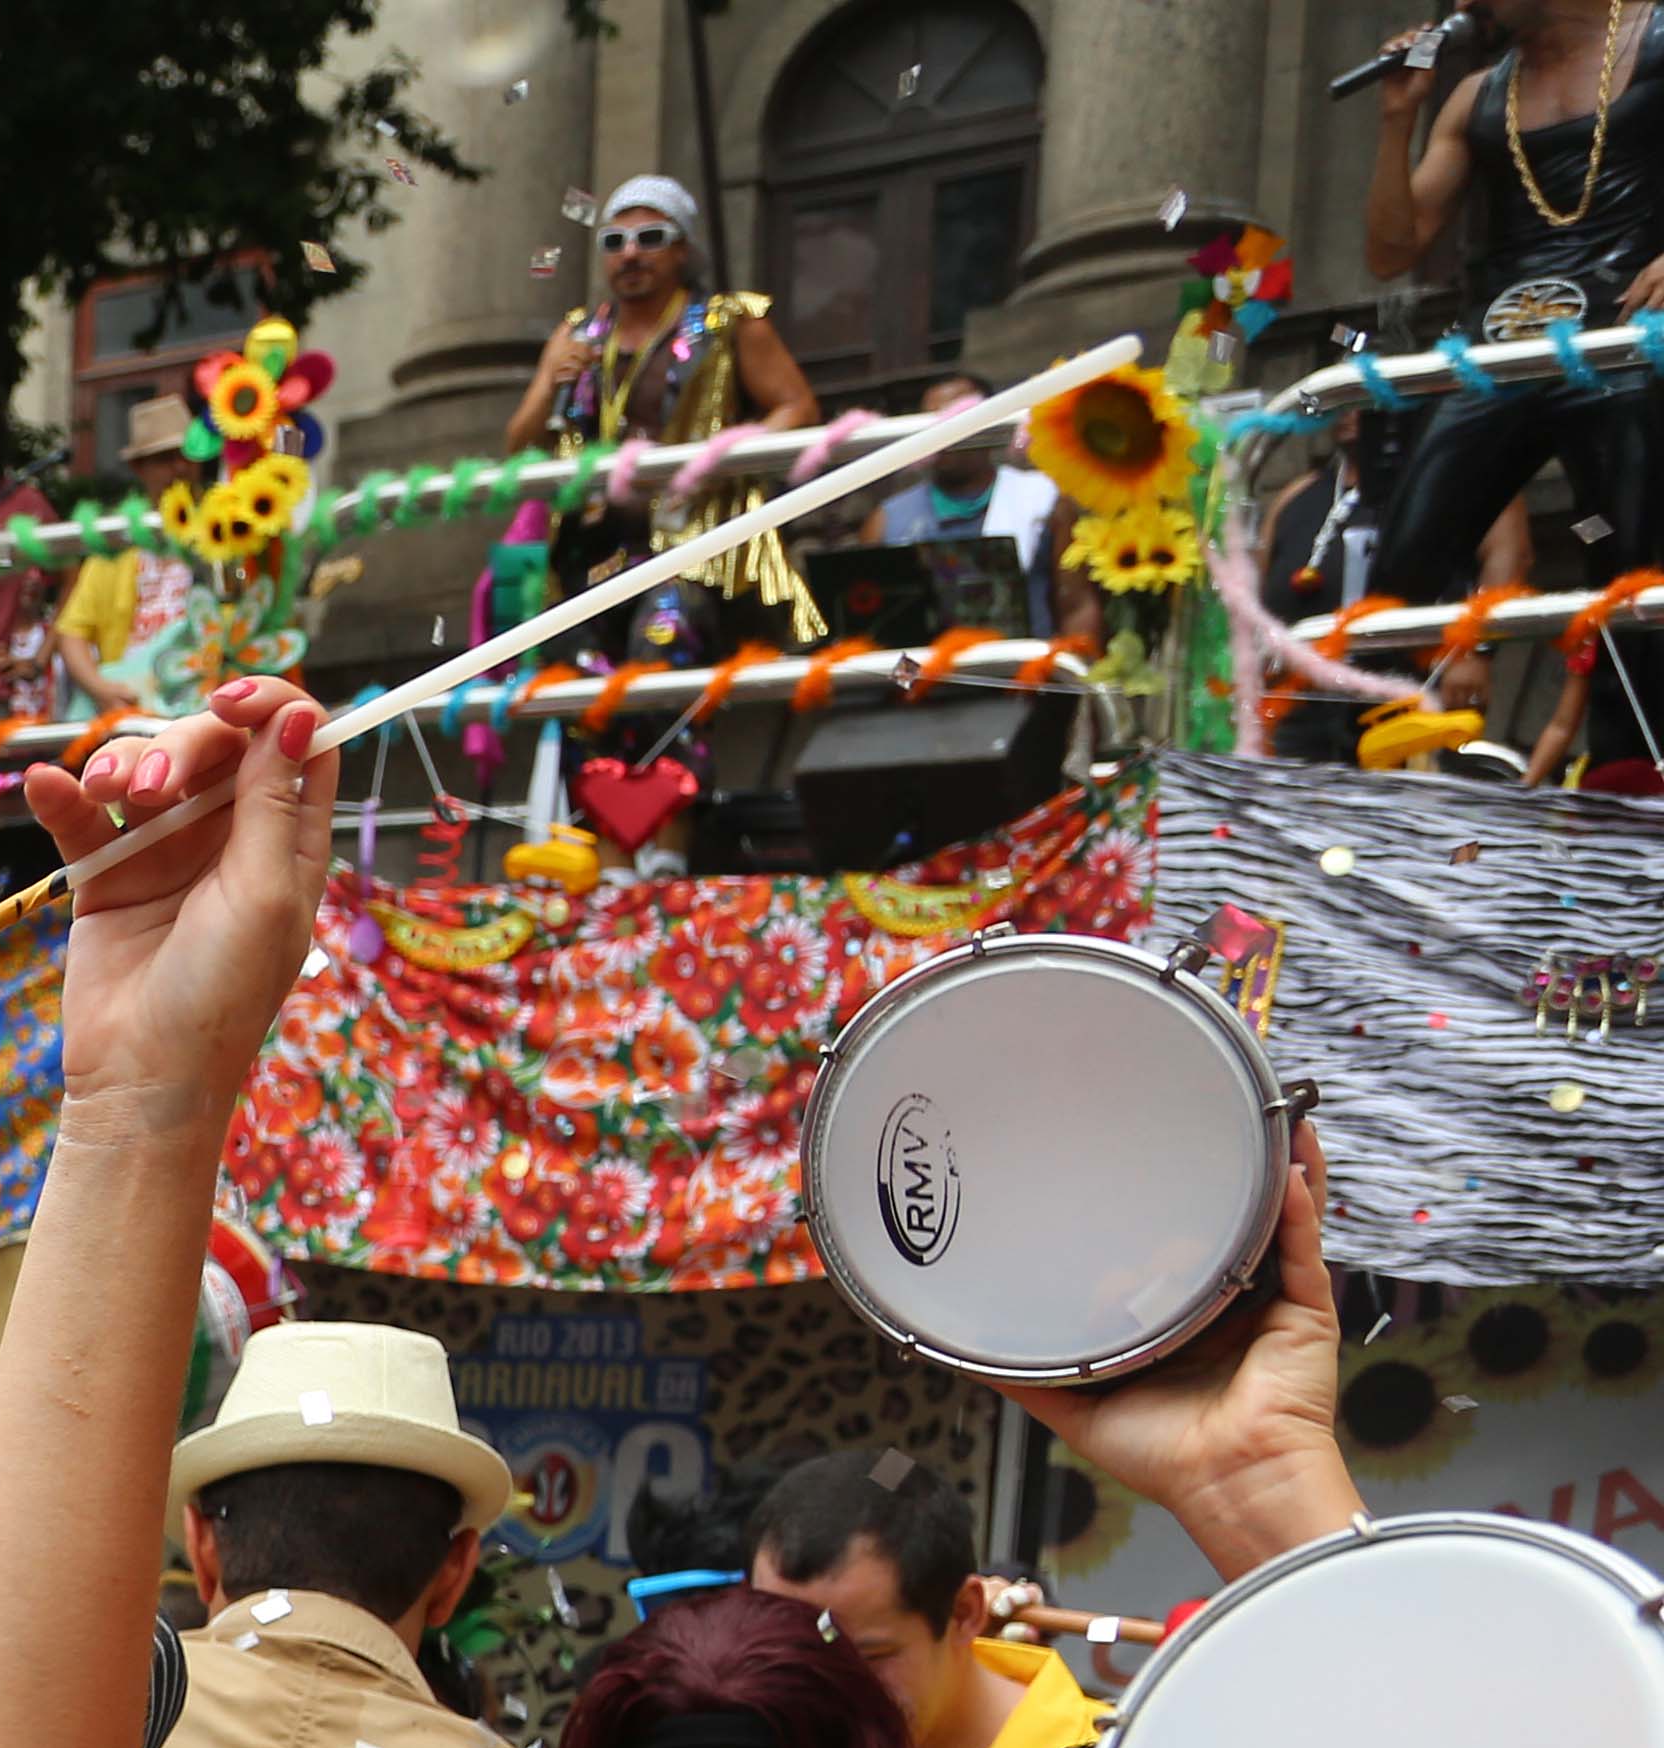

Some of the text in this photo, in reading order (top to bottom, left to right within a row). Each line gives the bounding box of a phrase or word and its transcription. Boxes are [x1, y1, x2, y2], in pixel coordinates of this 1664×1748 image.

[902, 1125, 938, 1234] RMV
[495, 1319, 638, 1359] RIO 2013
[456, 1359, 650, 1409] ARNAVAL
